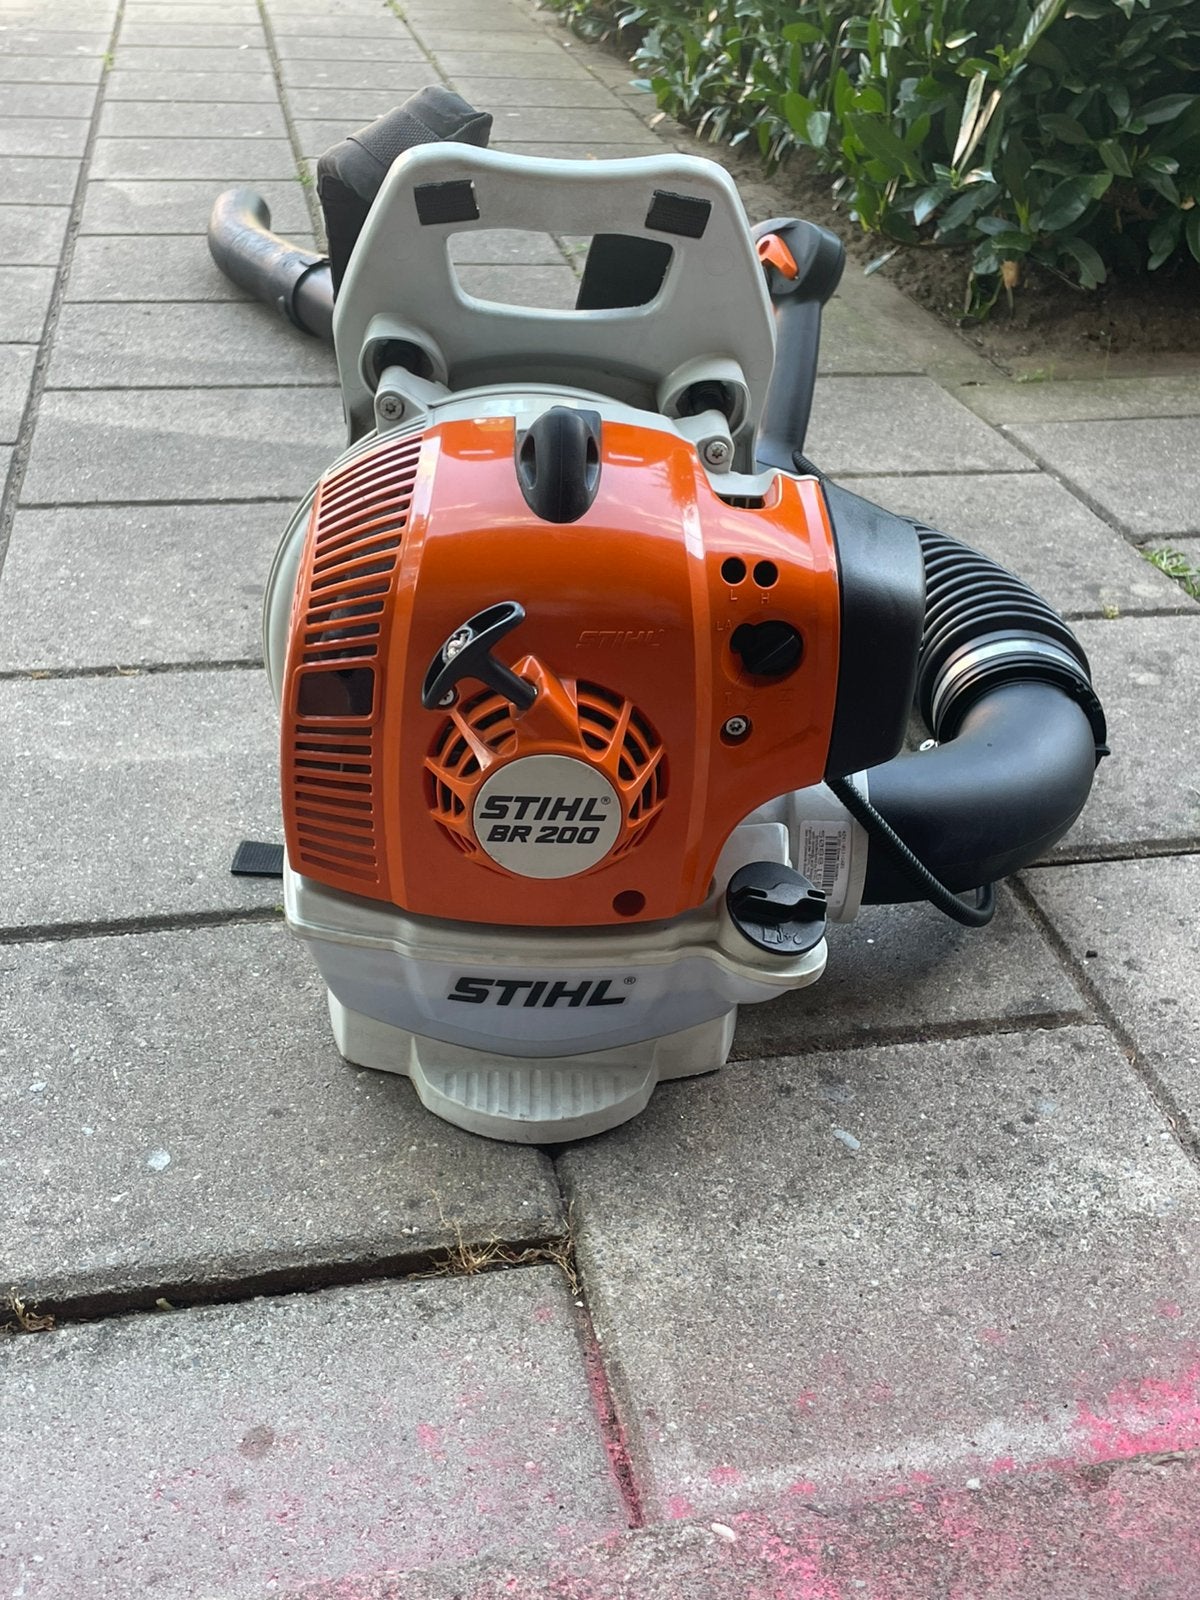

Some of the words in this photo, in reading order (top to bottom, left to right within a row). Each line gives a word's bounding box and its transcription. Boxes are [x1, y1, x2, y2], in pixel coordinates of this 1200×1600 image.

[479, 795, 607, 822] STIHL
[487, 825, 532, 843] BR
[534, 826, 600, 844] 200
[447, 976, 626, 1008] STIHL
